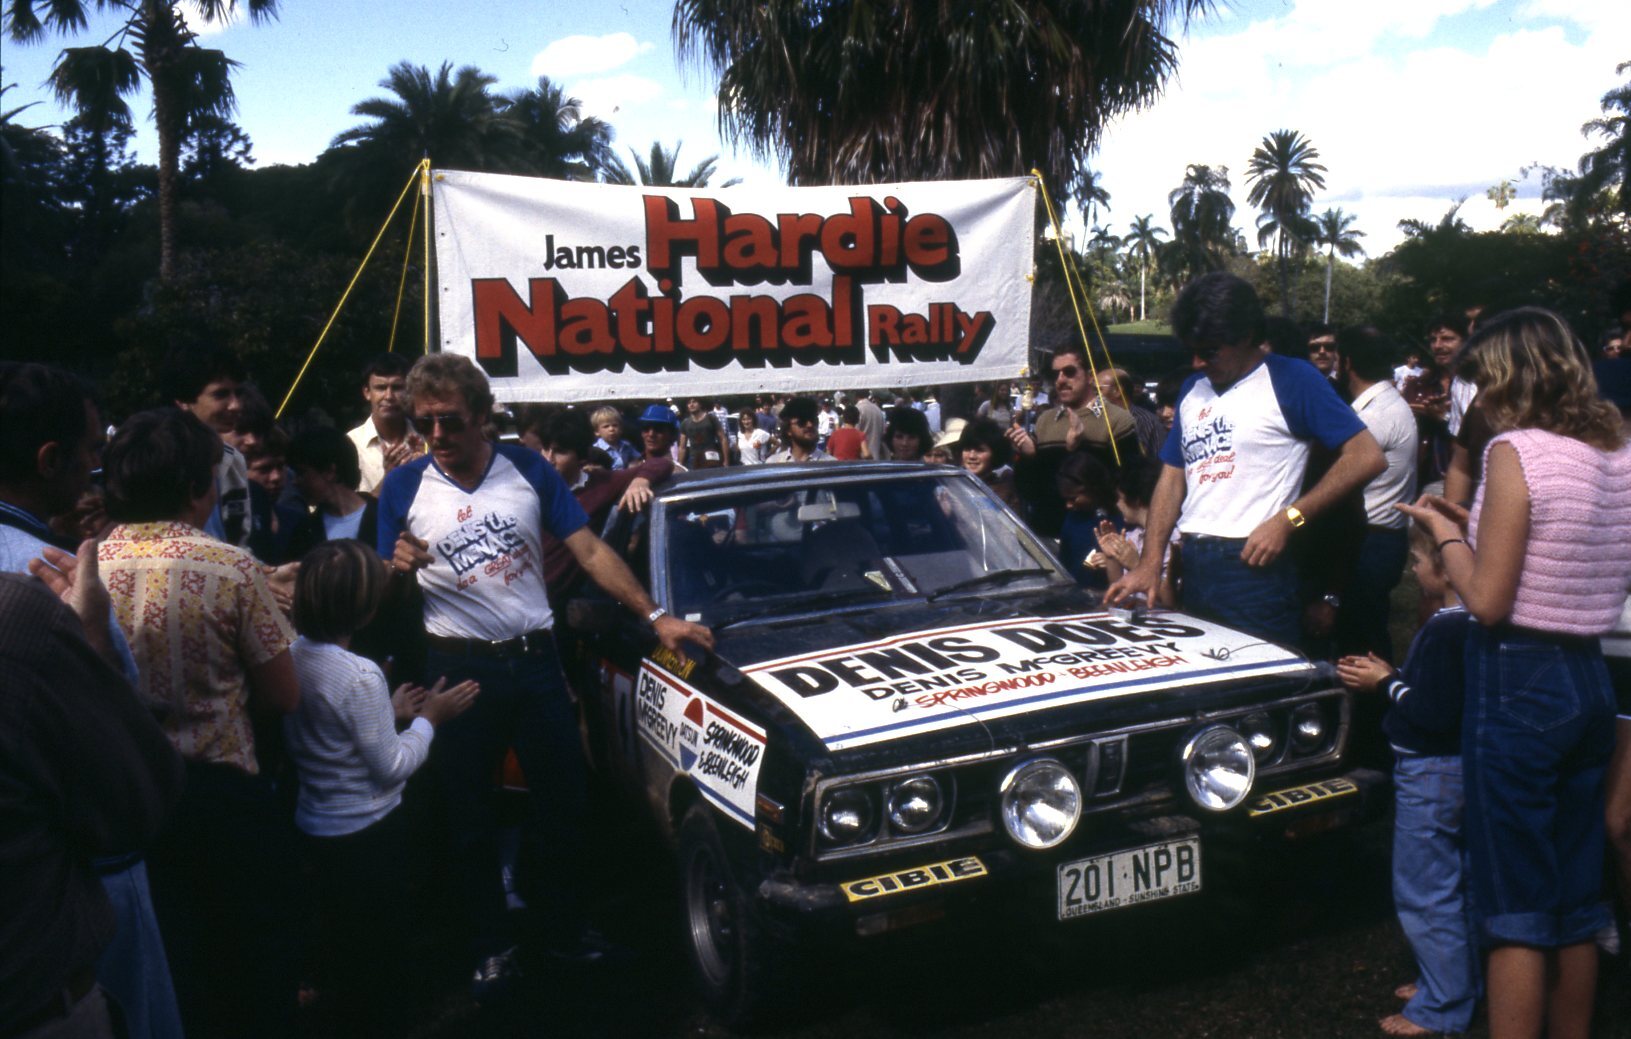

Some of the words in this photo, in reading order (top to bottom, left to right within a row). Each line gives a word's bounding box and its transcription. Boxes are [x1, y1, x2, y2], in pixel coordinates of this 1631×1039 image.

[543, 234, 641, 271] James
[642, 195, 961, 286] Hardie
[472, 275, 865, 378] National
[867, 302, 996, 365] Rally
[768, 637, 1001, 699] DENIS
[990, 617, 1206, 653] DOES
[638, 670, 668, 711] DENIS
[861, 667, 986, 701] DENIS
[914, 672, 1056, 709] SPRINGWOOD
[1069, 656, 1190, 681] BEENLEIGH
[680, 721, 698, 748] DATSUN
[702, 720, 760, 768] SPRINGWOOD
[849, 858, 983, 897] CIBIE
[1066, 897, 1121, 917] QUEENSLAND
